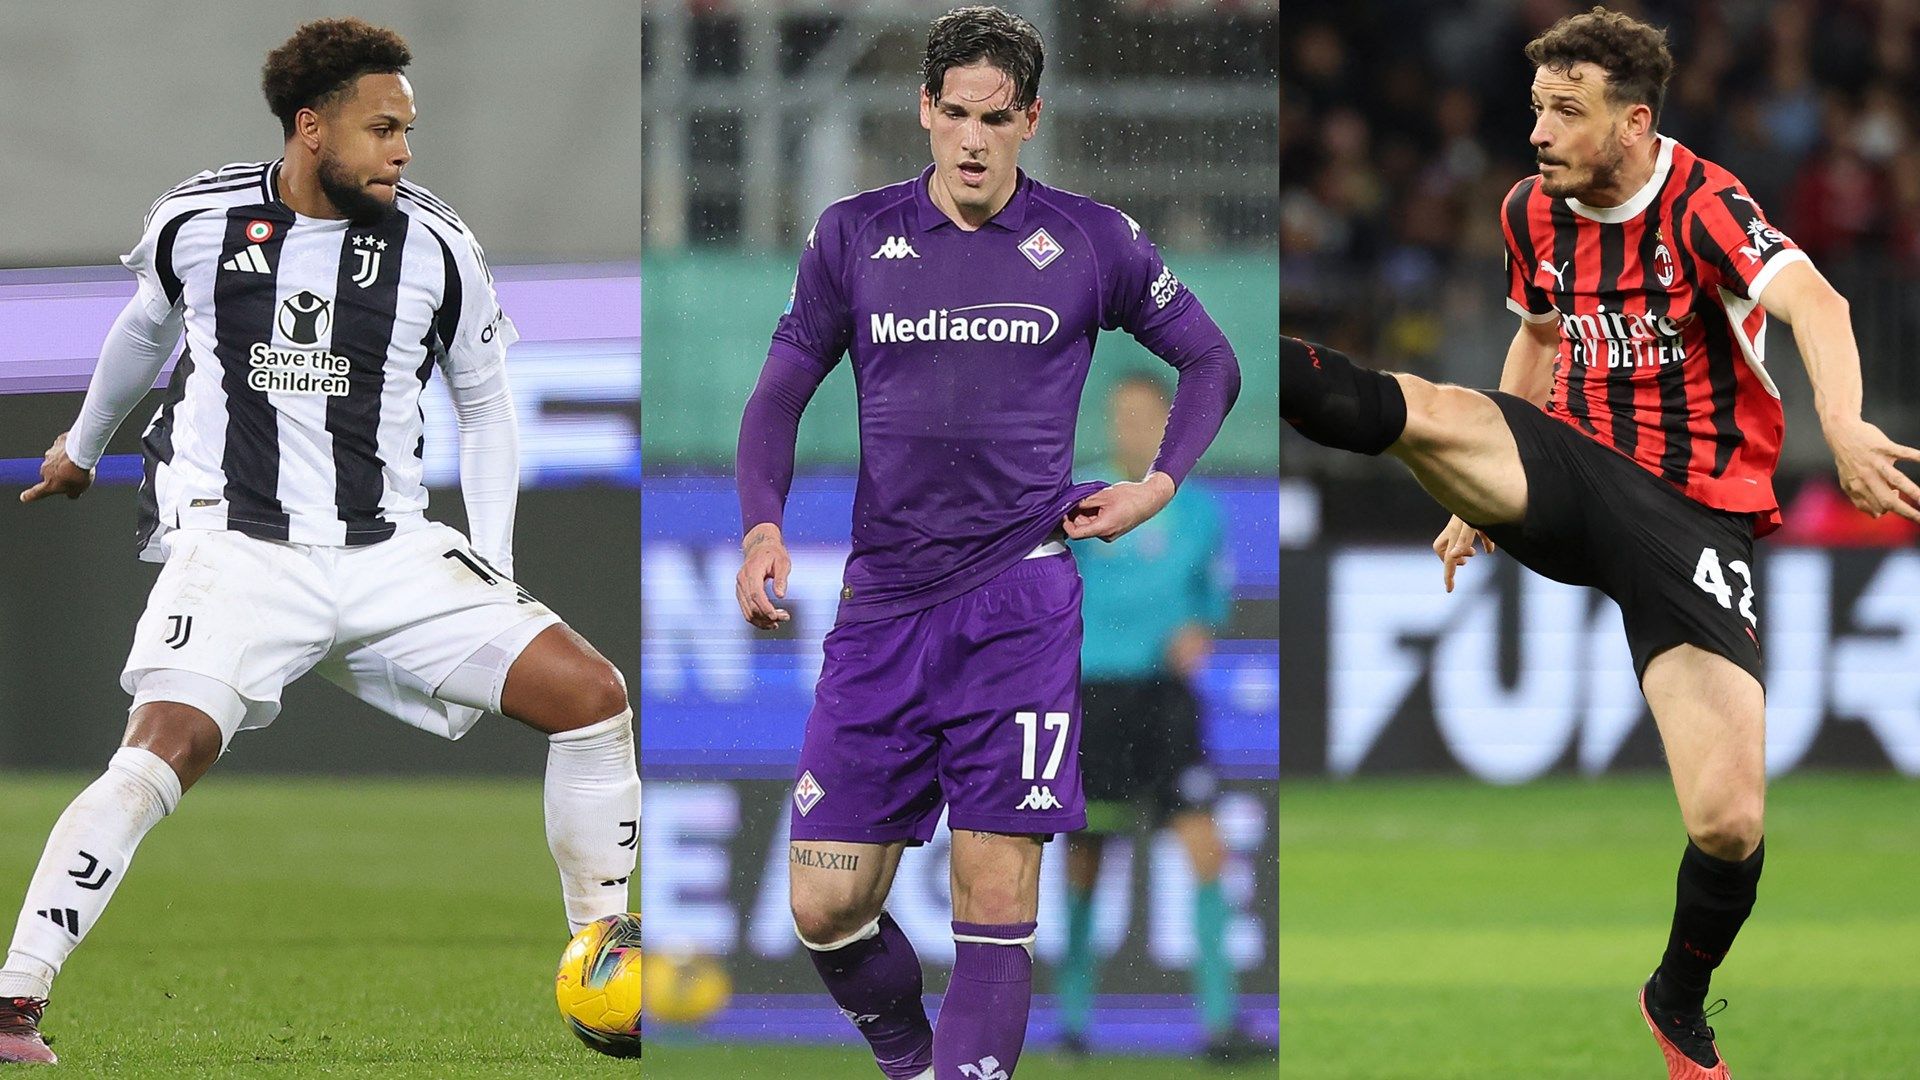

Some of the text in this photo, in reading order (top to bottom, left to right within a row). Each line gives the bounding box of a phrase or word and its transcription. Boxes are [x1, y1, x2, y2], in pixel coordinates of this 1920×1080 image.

[1739, 228, 1797, 265] MS
[870, 308, 1041, 345] Mediacom
[1554, 304, 1696, 340] mirate
[252, 345, 348, 373] Save the
[1607, 337, 1687, 368] BETTER
[251, 370, 347, 393] Children
[1692, 547, 1758, 630] 42
[1014, 711, 1070, 780] 17
